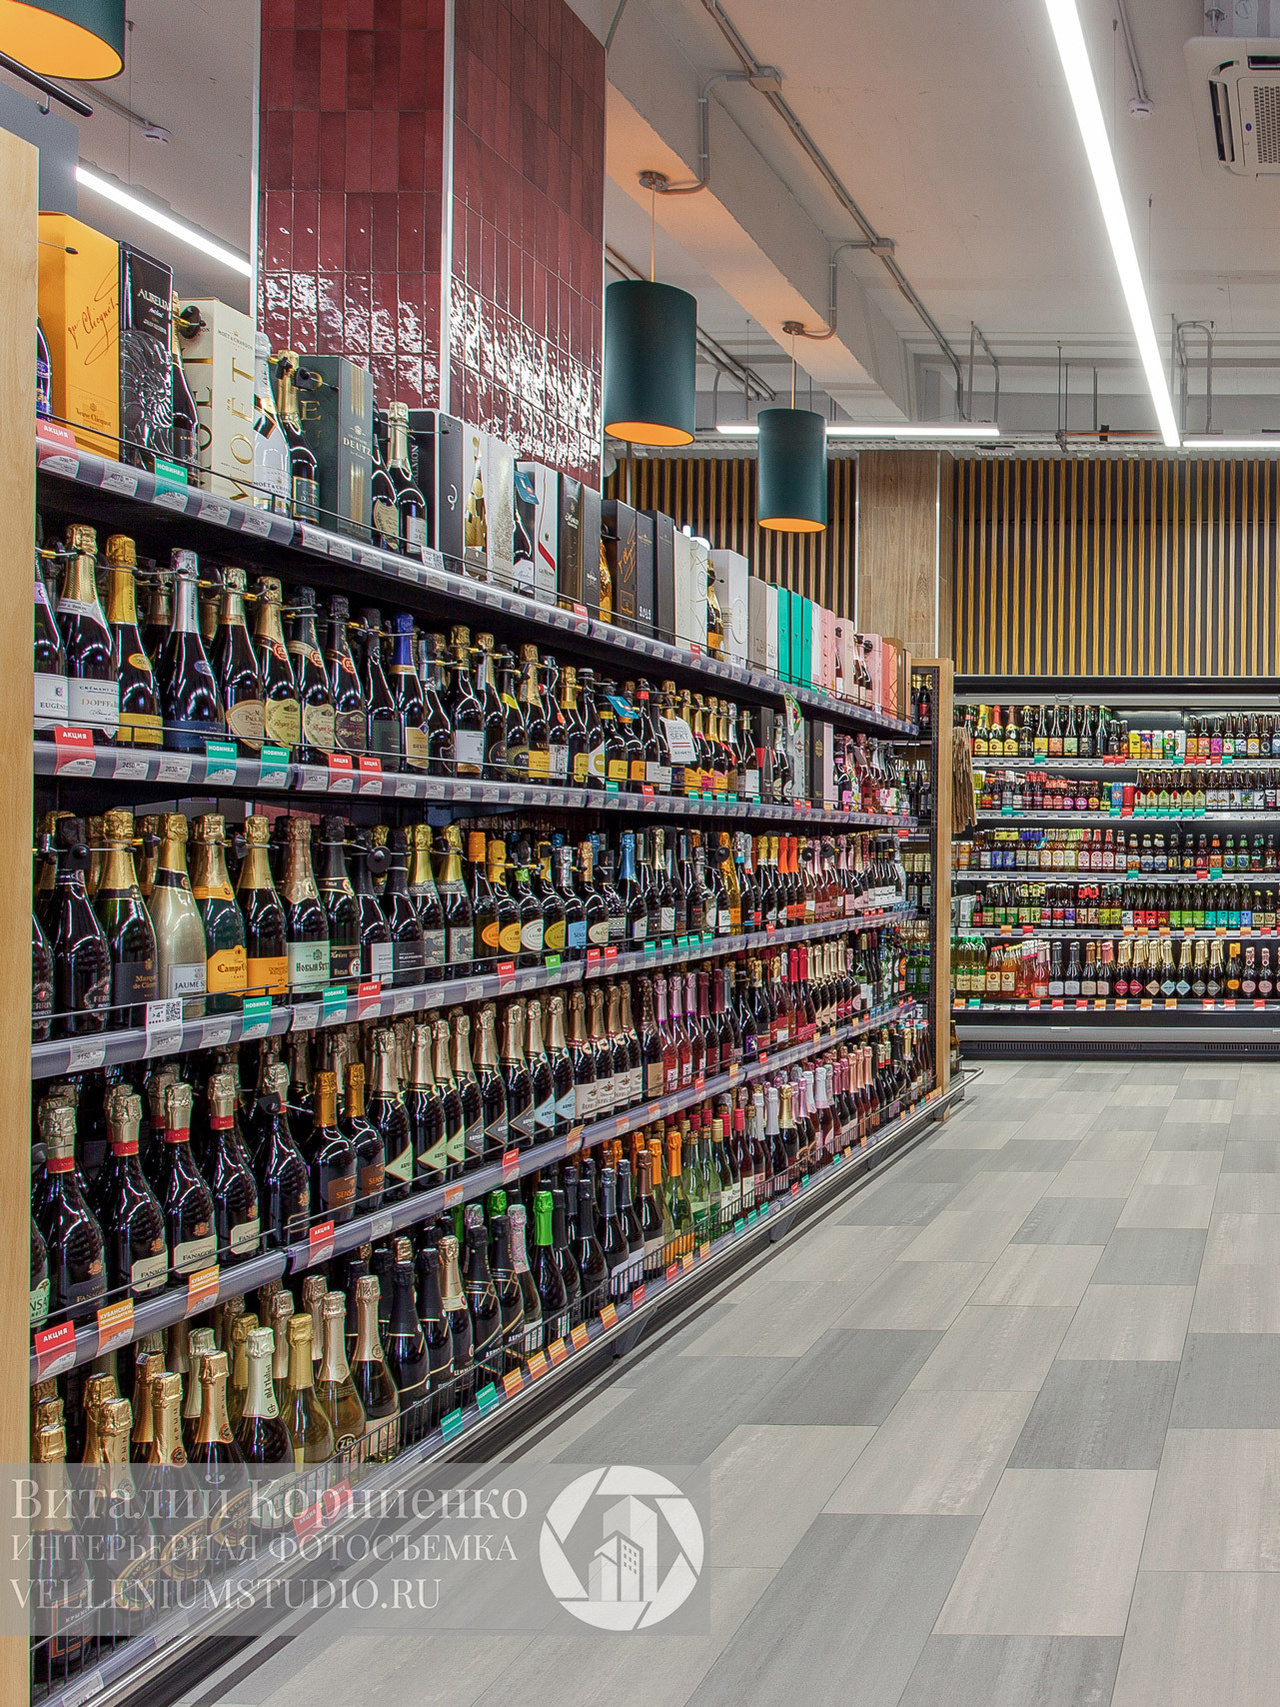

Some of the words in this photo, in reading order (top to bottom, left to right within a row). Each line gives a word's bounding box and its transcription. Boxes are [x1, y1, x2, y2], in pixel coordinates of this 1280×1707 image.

[43, 425, 69, 439] АКЦИЯ
[343, 437, 372, 456] DEUTZ
[157, 463, 185, 477] НОВИНКА
[62, 731, 87, 740] АКЦИЯ
[669, 732, 688, 740] SEKT
[314, 1226, 331, 1235] АКЦИЯ
[191, 1269, 219, 1283] КУБАНСКИЙ
[100, 1303, 133, 1320] КУБАНСКИЙ
[43, 1328, 68, 1342] АКЦИЯ
